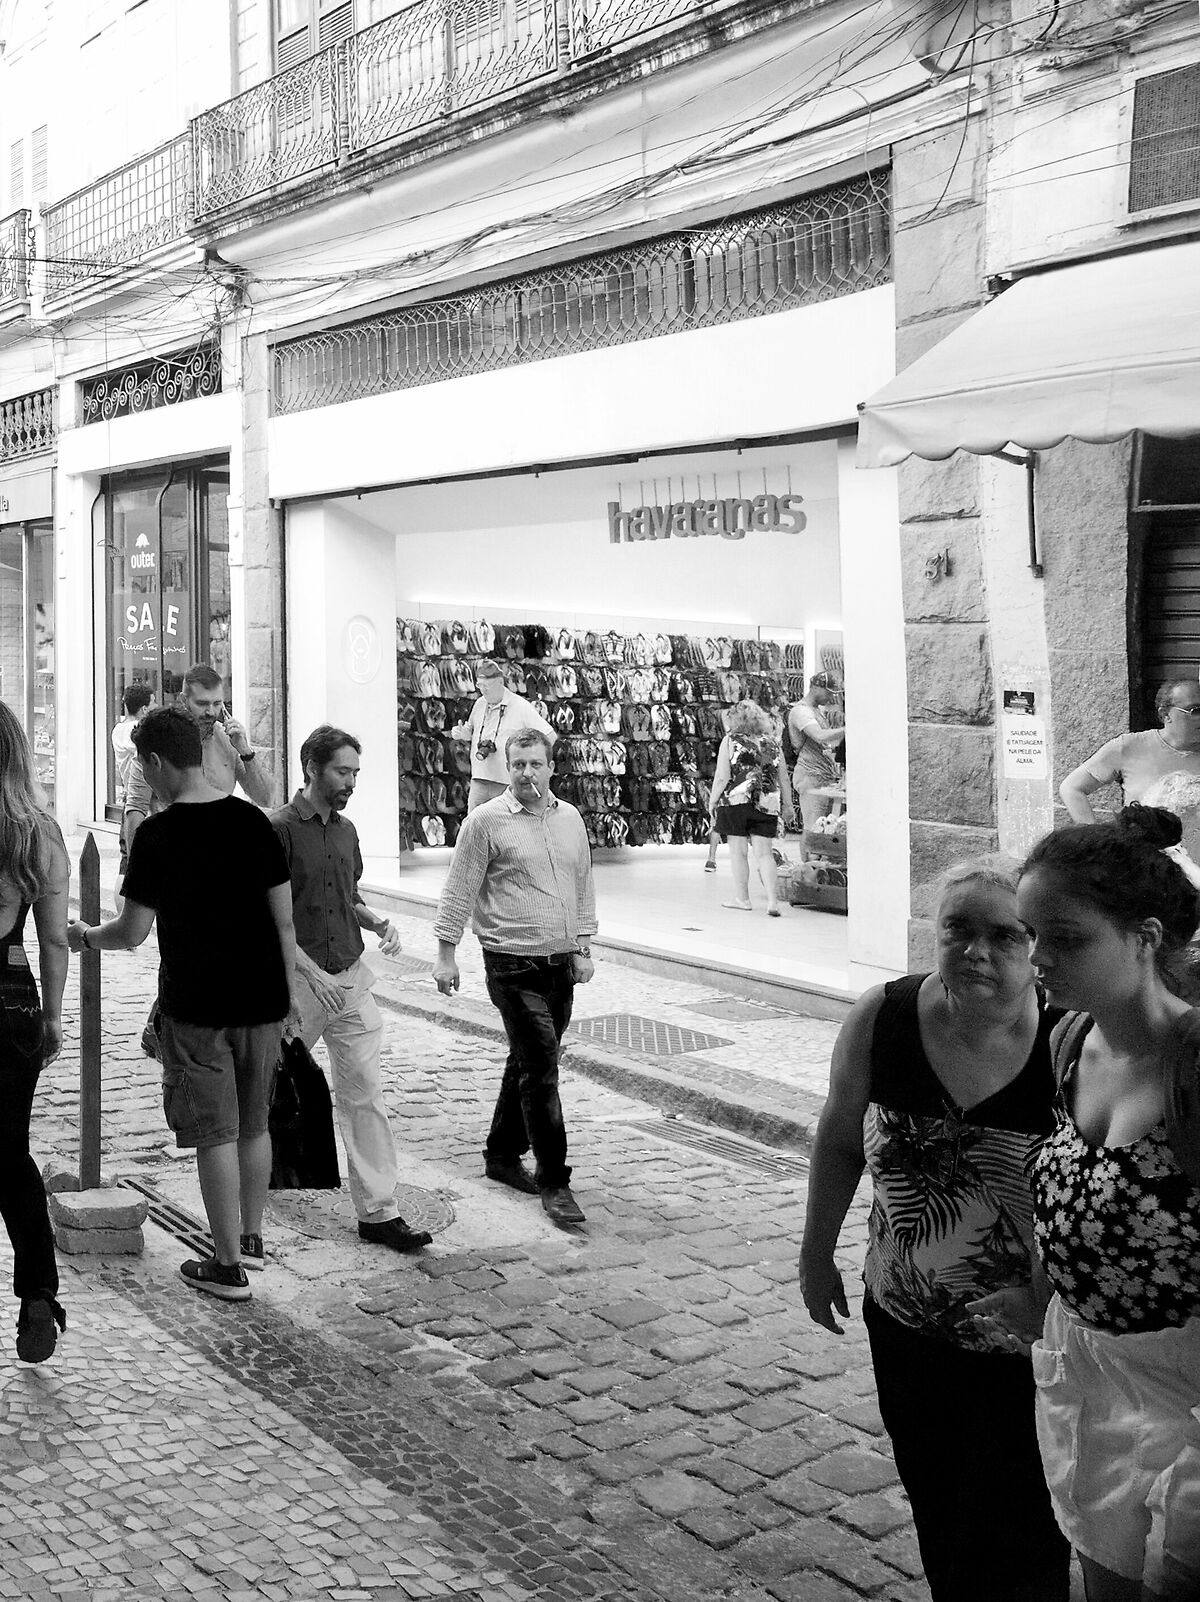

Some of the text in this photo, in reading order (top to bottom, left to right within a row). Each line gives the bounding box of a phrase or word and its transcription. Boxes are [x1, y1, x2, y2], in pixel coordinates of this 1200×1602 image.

[126, 602, 180, 636] SAE
[1008, 748, 1017, 756] NA
[1032, 748, 1042, 756] DA
